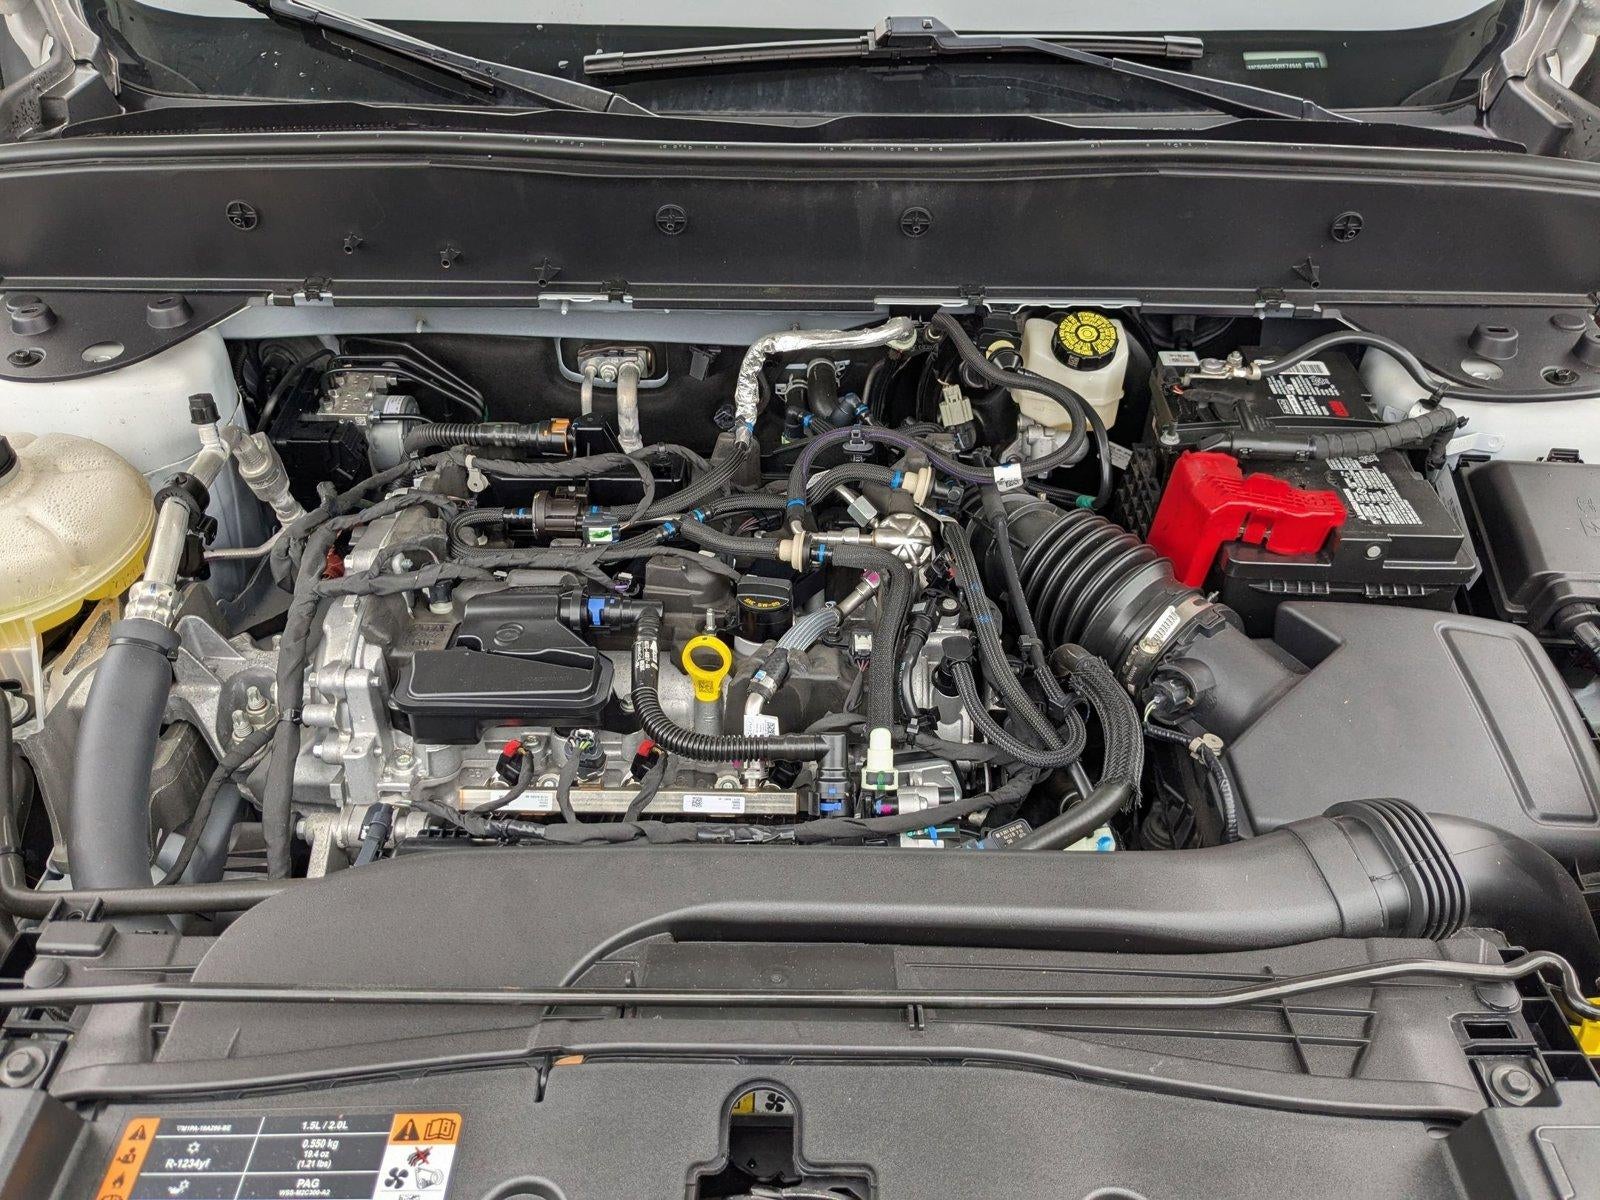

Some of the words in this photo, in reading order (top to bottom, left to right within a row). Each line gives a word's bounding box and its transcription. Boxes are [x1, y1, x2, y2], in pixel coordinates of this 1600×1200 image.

[302, 1121, 320, 1130] 1.5L
[322, 1120, 328, 1130] /
[328, 1120, 348, 1130] 2.0L
[302, 1138, 326, 1149] 0.550
[327, 1138, 339, 1150] kg
[304, 1149, 319, 1158] 19.4
[165, 1157, 212, 1170] R-1234yf
[297, 1159, 315, 1170] (1.21
[316, 1159, 332, 1169] lbs)
[296, 1178, 320, 1189] PAG
